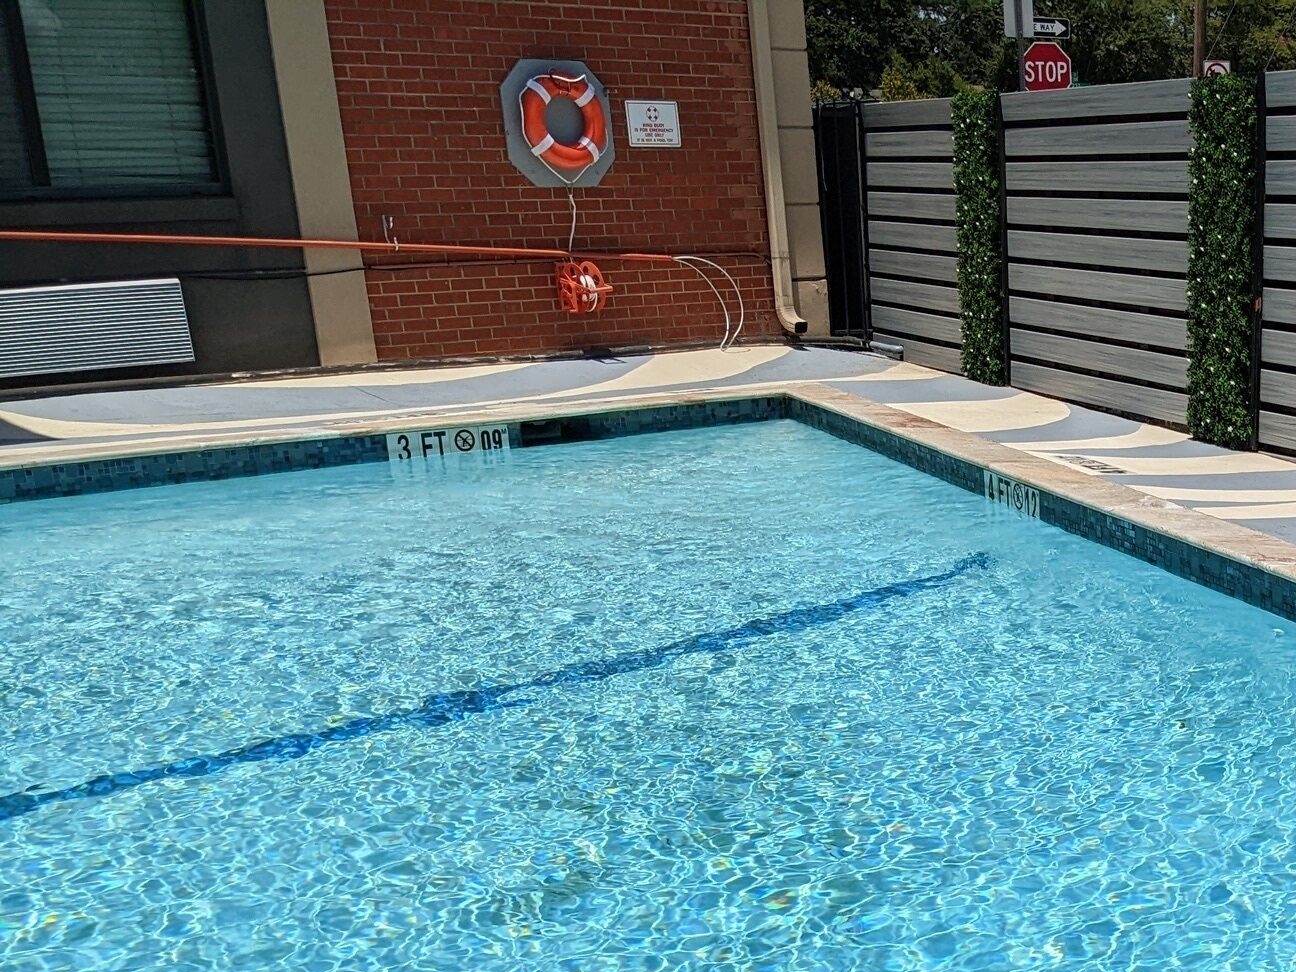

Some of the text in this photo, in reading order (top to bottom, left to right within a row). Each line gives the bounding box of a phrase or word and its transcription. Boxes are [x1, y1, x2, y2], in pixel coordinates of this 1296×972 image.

[1025, 61, 1068, 82] STOP
[397, 434, 412, 460] 3
[420, 431, 446, 458] FT
[988, 474, 995, 501] 4
[998, 477, 1011, 509] FT
